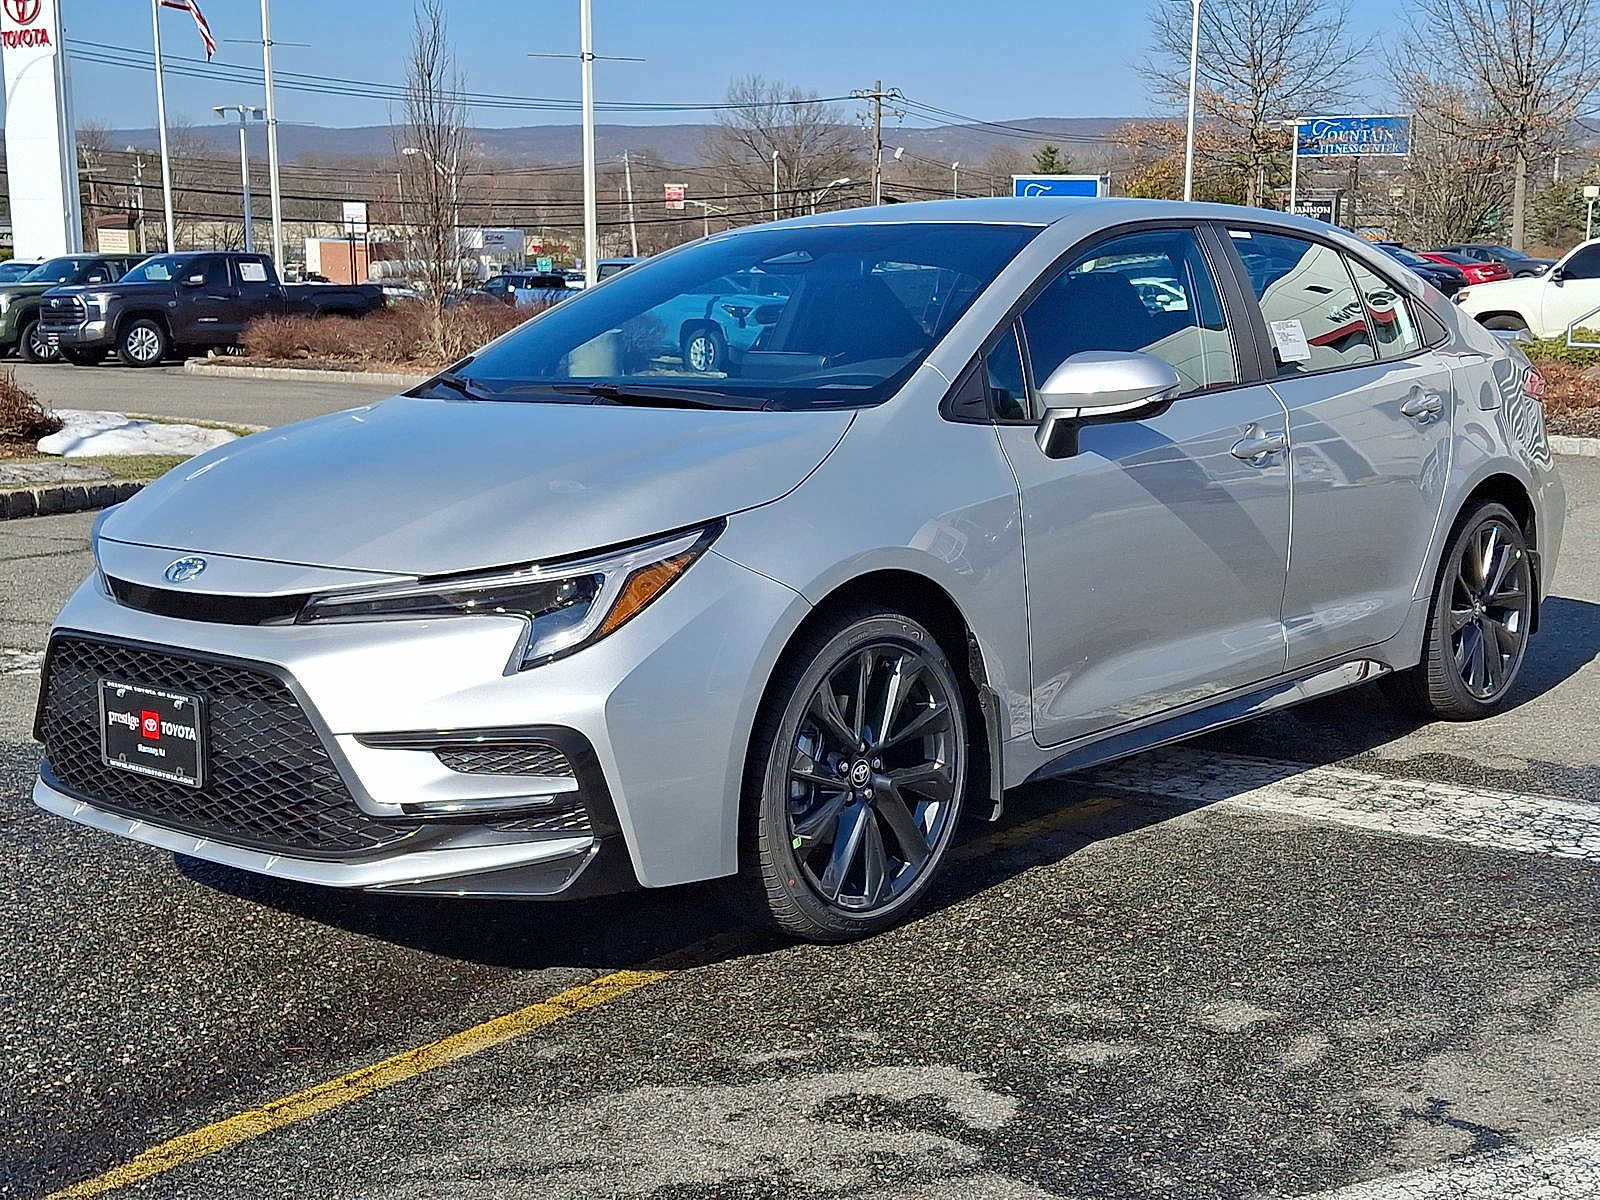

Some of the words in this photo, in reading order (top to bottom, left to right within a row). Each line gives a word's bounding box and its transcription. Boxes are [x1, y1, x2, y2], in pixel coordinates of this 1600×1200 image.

[1, 28, 50, 47] TOYOTA
[108, 711, 140, 730] prestige
[160, 721, 197, 741] TOYOTA
